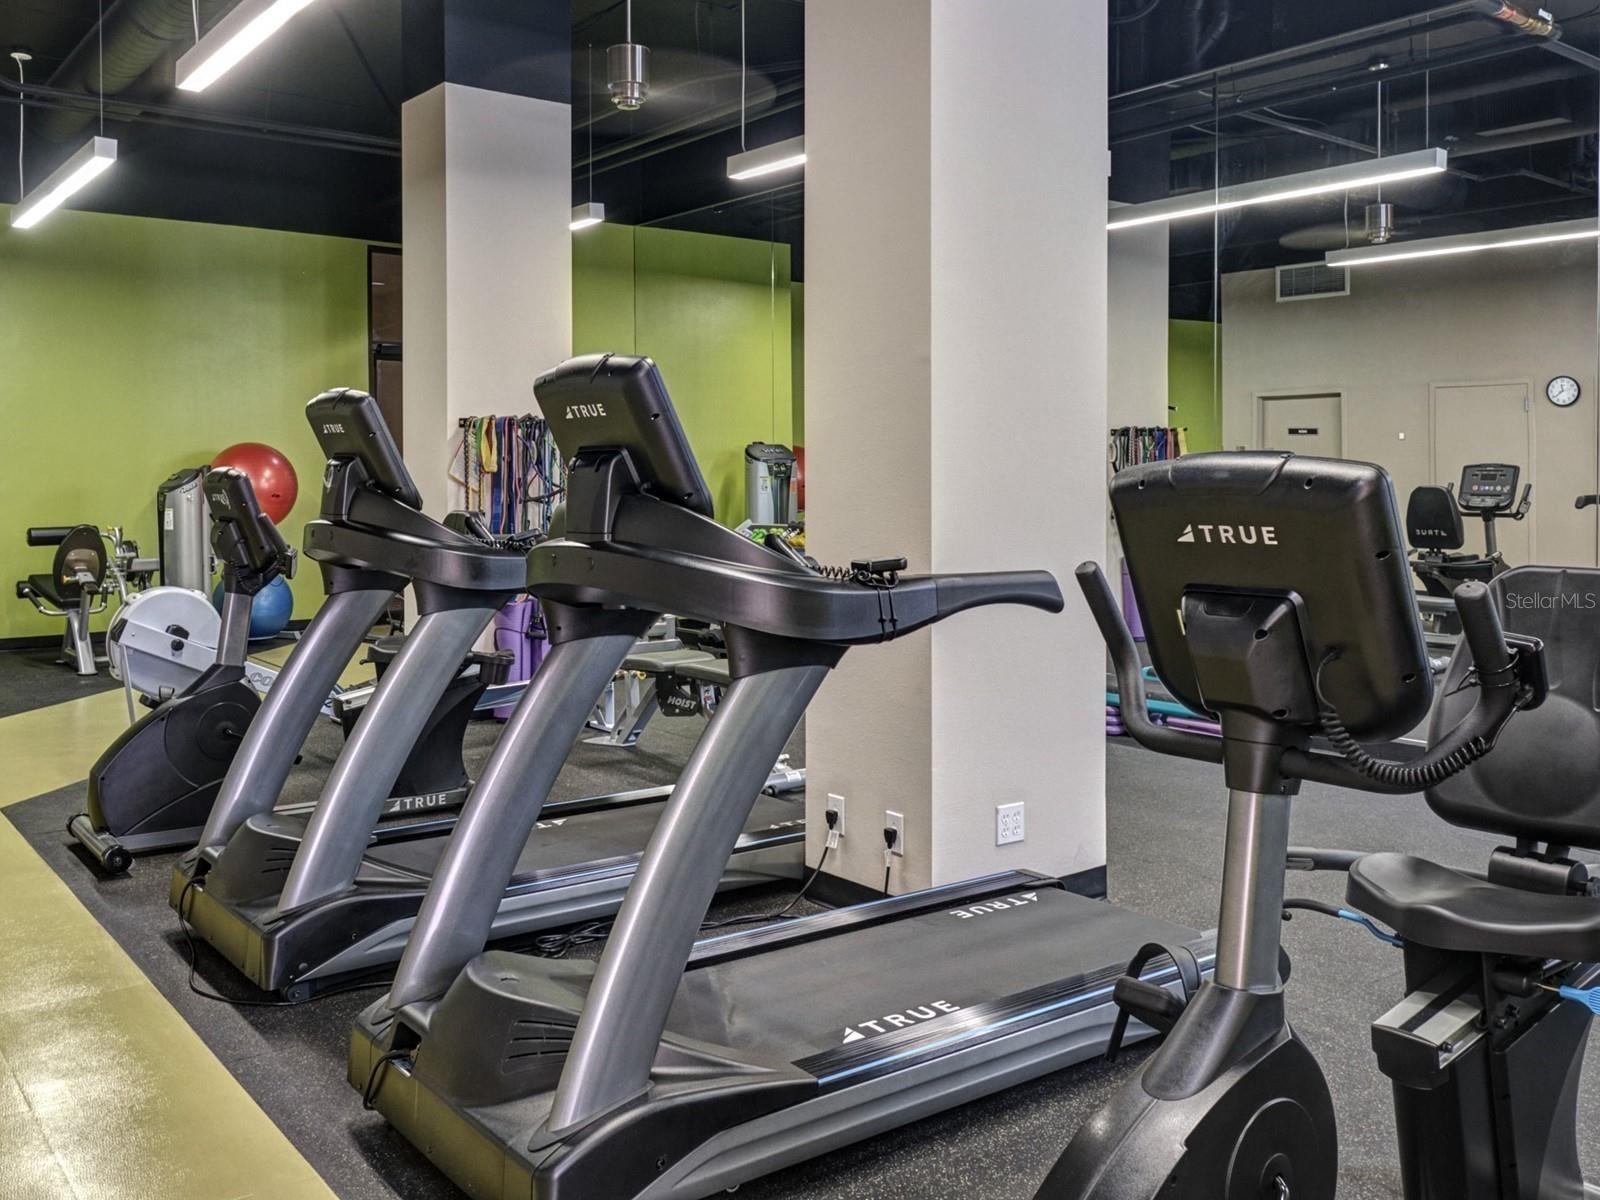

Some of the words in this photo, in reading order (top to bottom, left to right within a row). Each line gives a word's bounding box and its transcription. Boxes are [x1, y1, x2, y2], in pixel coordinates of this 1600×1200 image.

[571, 403, 607, 418] TRUE
[326, 423, 345, 433] TRUE
[1198, 524, 1279, 545] TRUE
[667, 695, 697, 709] HOIST
[403, 794, 447, 809] TRUE
[949, 898, 1029, 919] TRUE
[858, 1000, 961, 1033] TRUE
